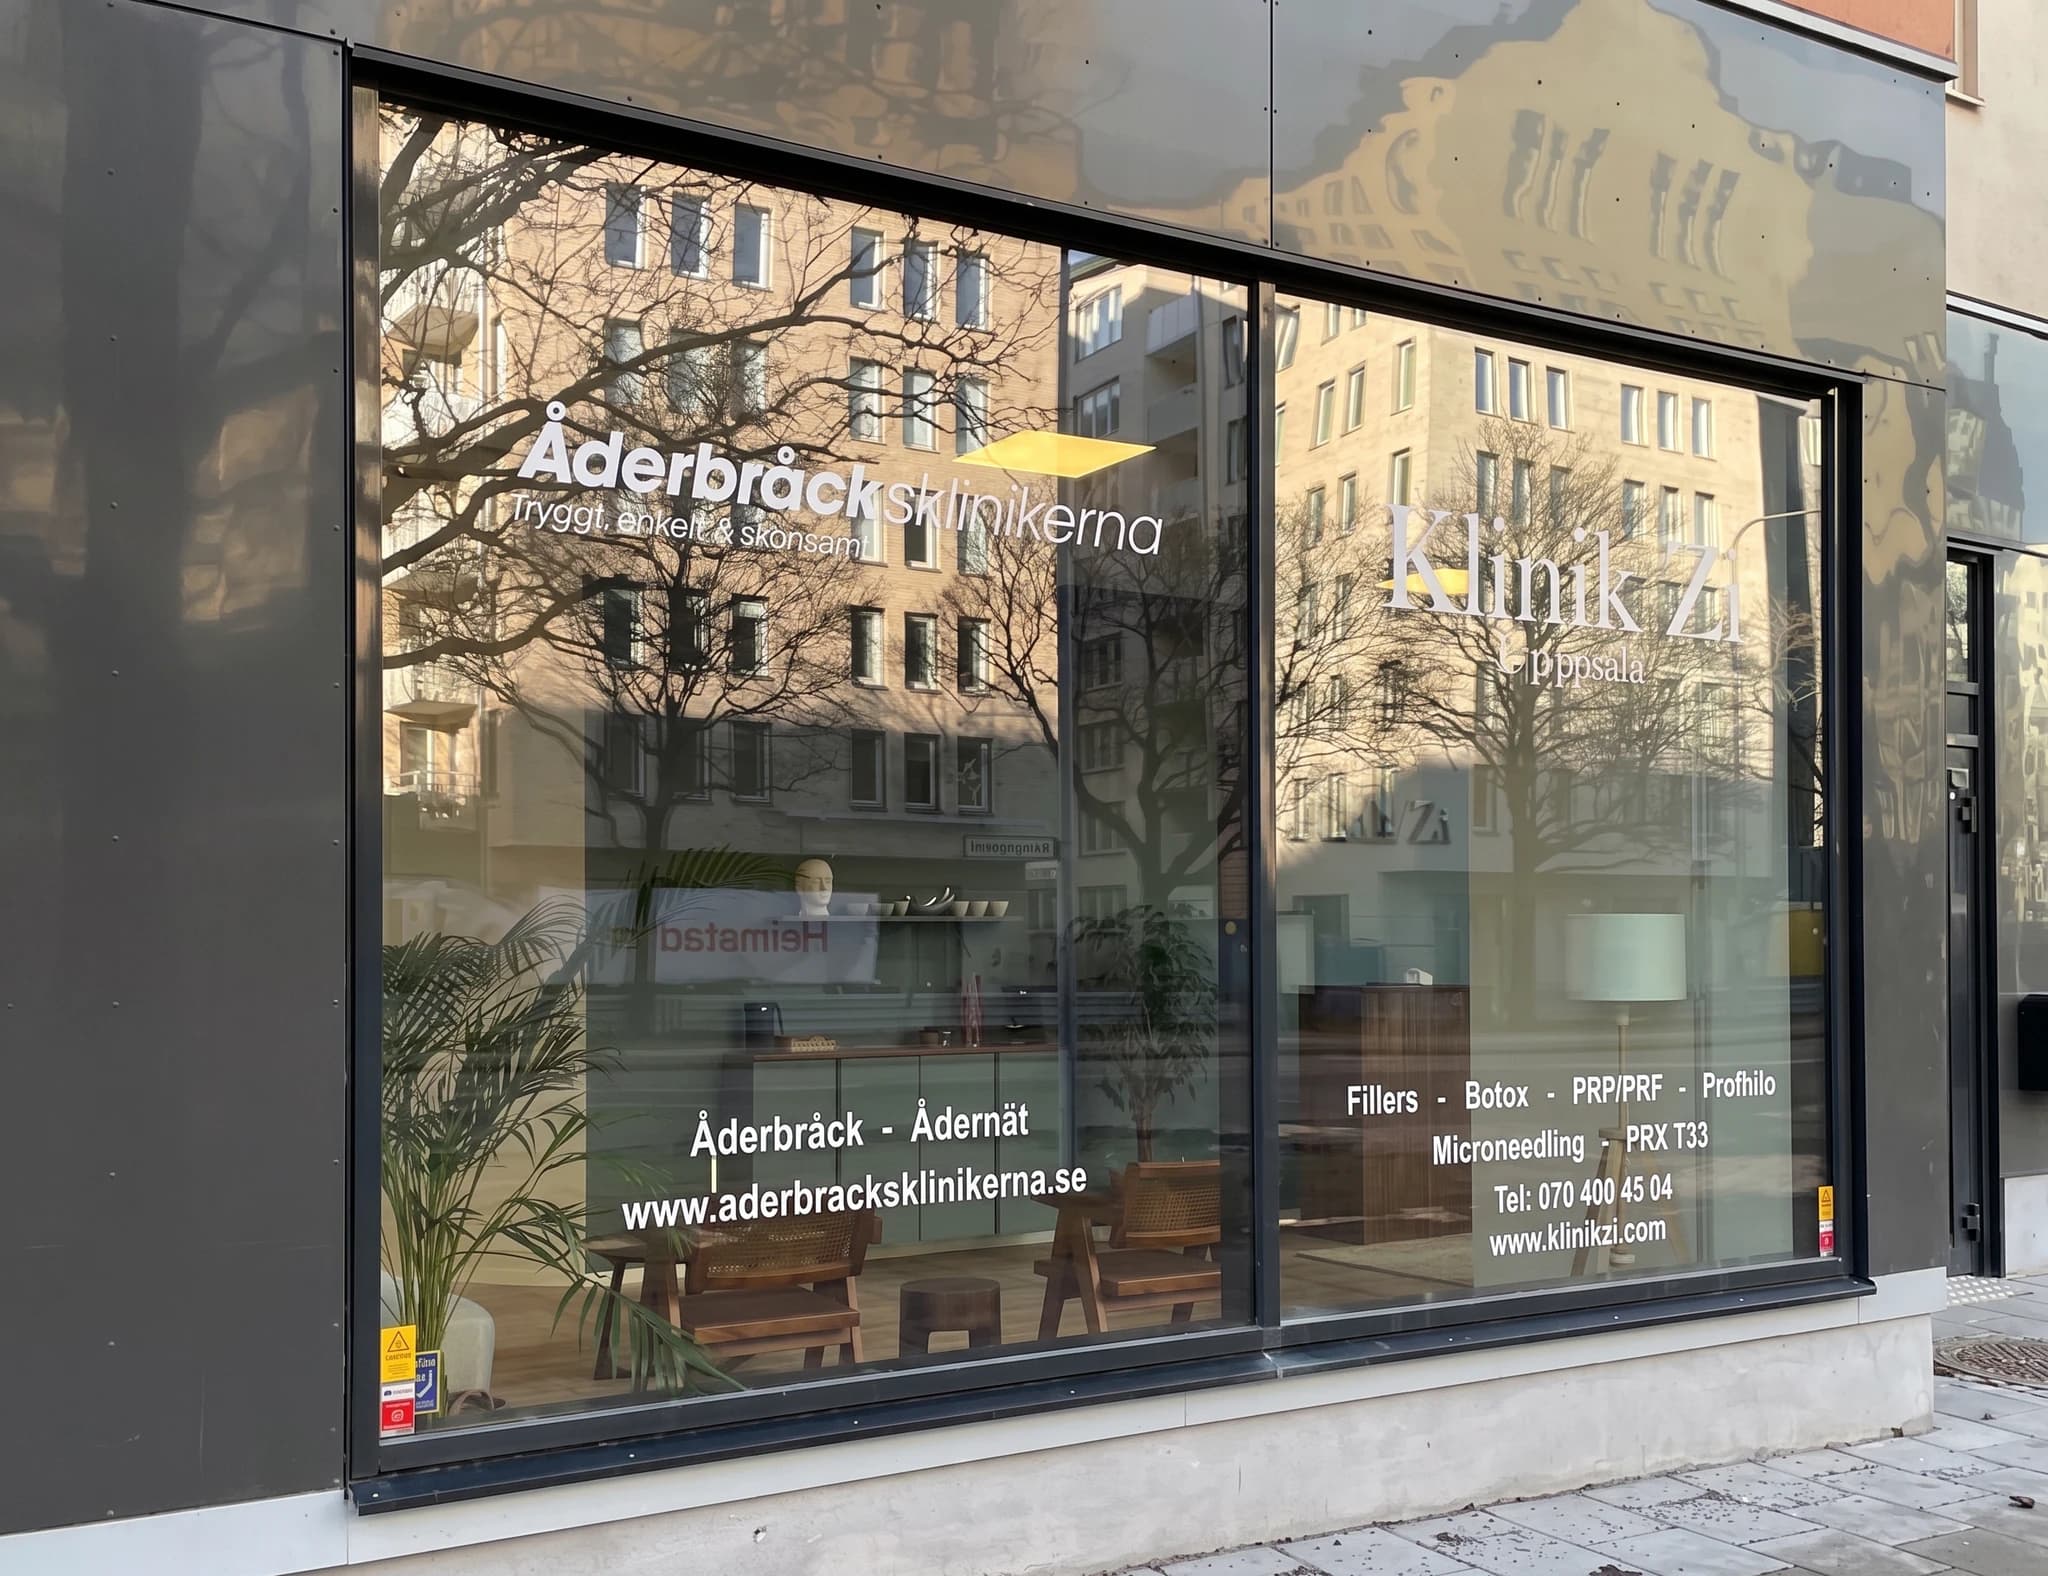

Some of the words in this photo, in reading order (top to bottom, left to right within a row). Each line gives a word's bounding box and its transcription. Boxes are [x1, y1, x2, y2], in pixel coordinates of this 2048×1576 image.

[517, 401, 1164, 555] Åderbråcksklinikerna
[511, 494, 610, 533] Tryggt,
[618, 511, 704, 541] enkelt
[719, 518, 734, 544] &
[740, 525, 870, 557] skonsamt
[1381, 503, 1644, 633] Klinik
[1665, 541, 1744, 643] Zi
[1347, 1084, 1419, 1116] Fillers
[1465, 1080, 1529, 1110] Botox
[1572, 1074, 1664, 1104] PRP/PRF
[1702, 1070, 1777, 1098] Profhilo
[690, 1110, 864, 1157] Åderbråck
[910, 1098, 1030, 1142] Ådernät
[1432, 1129, 1586, 1166] Microneedling
[1626, 1124, 1668, 1153] PRX
[1673, 1121, 1709, 1150] T33
[622, 1164, 1087, 1231] www.aderbracksklinikerna.se
[1494, 1184, 1532, 1214] Tel:
[1538, 1181, 1574, 1210] 070
[1580, 1178, 1615, 1207] 400
[1620, 1176, 1645, 1204] 45
[1649, 1173, 1673, 1201] 04
[1489, 1217, 1667, 1257] www.klinikzi.com
